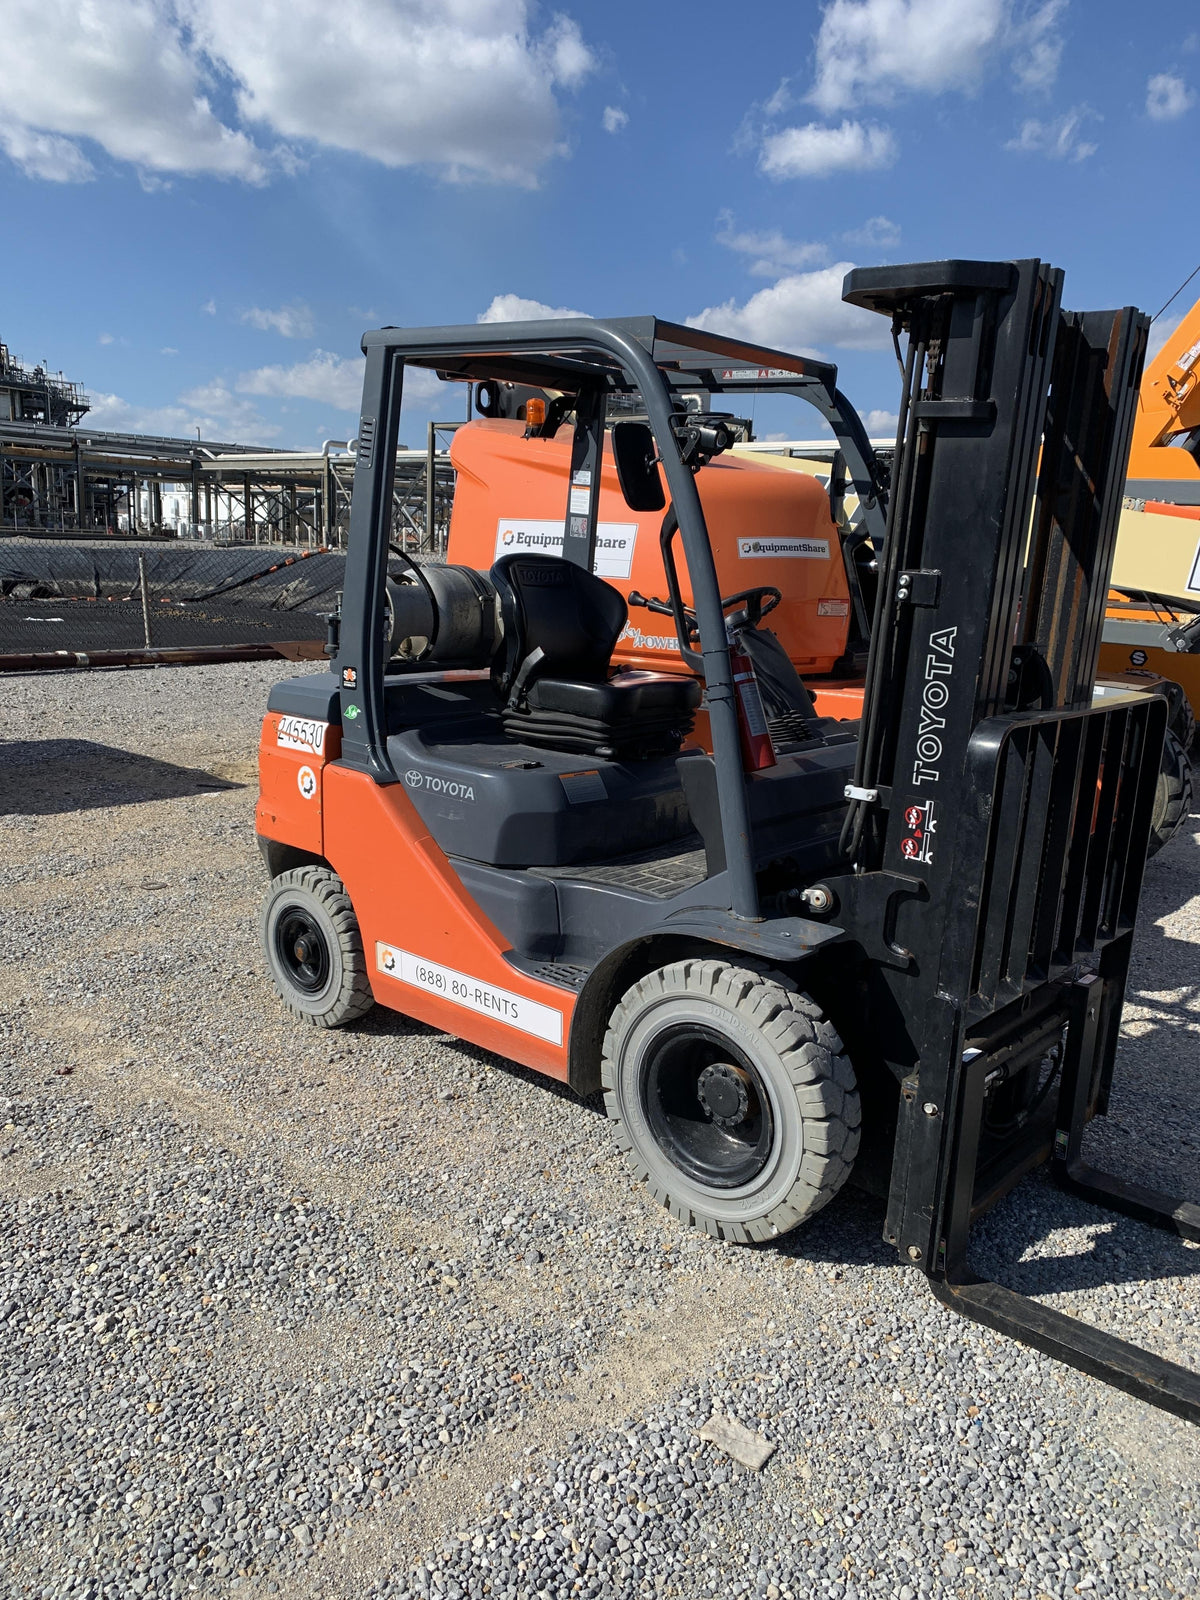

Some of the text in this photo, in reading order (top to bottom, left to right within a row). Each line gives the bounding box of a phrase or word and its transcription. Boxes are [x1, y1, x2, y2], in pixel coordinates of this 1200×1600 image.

[516, 532, 627, 549] Equipmhare
[912, 626, 958, 786] TOYOTA
[278, 718, 323, 748] 245530
[425, 775, 475, 800] TOYOTA
[415, 965, 519, 1019] (888) 80-RENTS
[705, 1005, 761, 1050] SOLIDEAL
